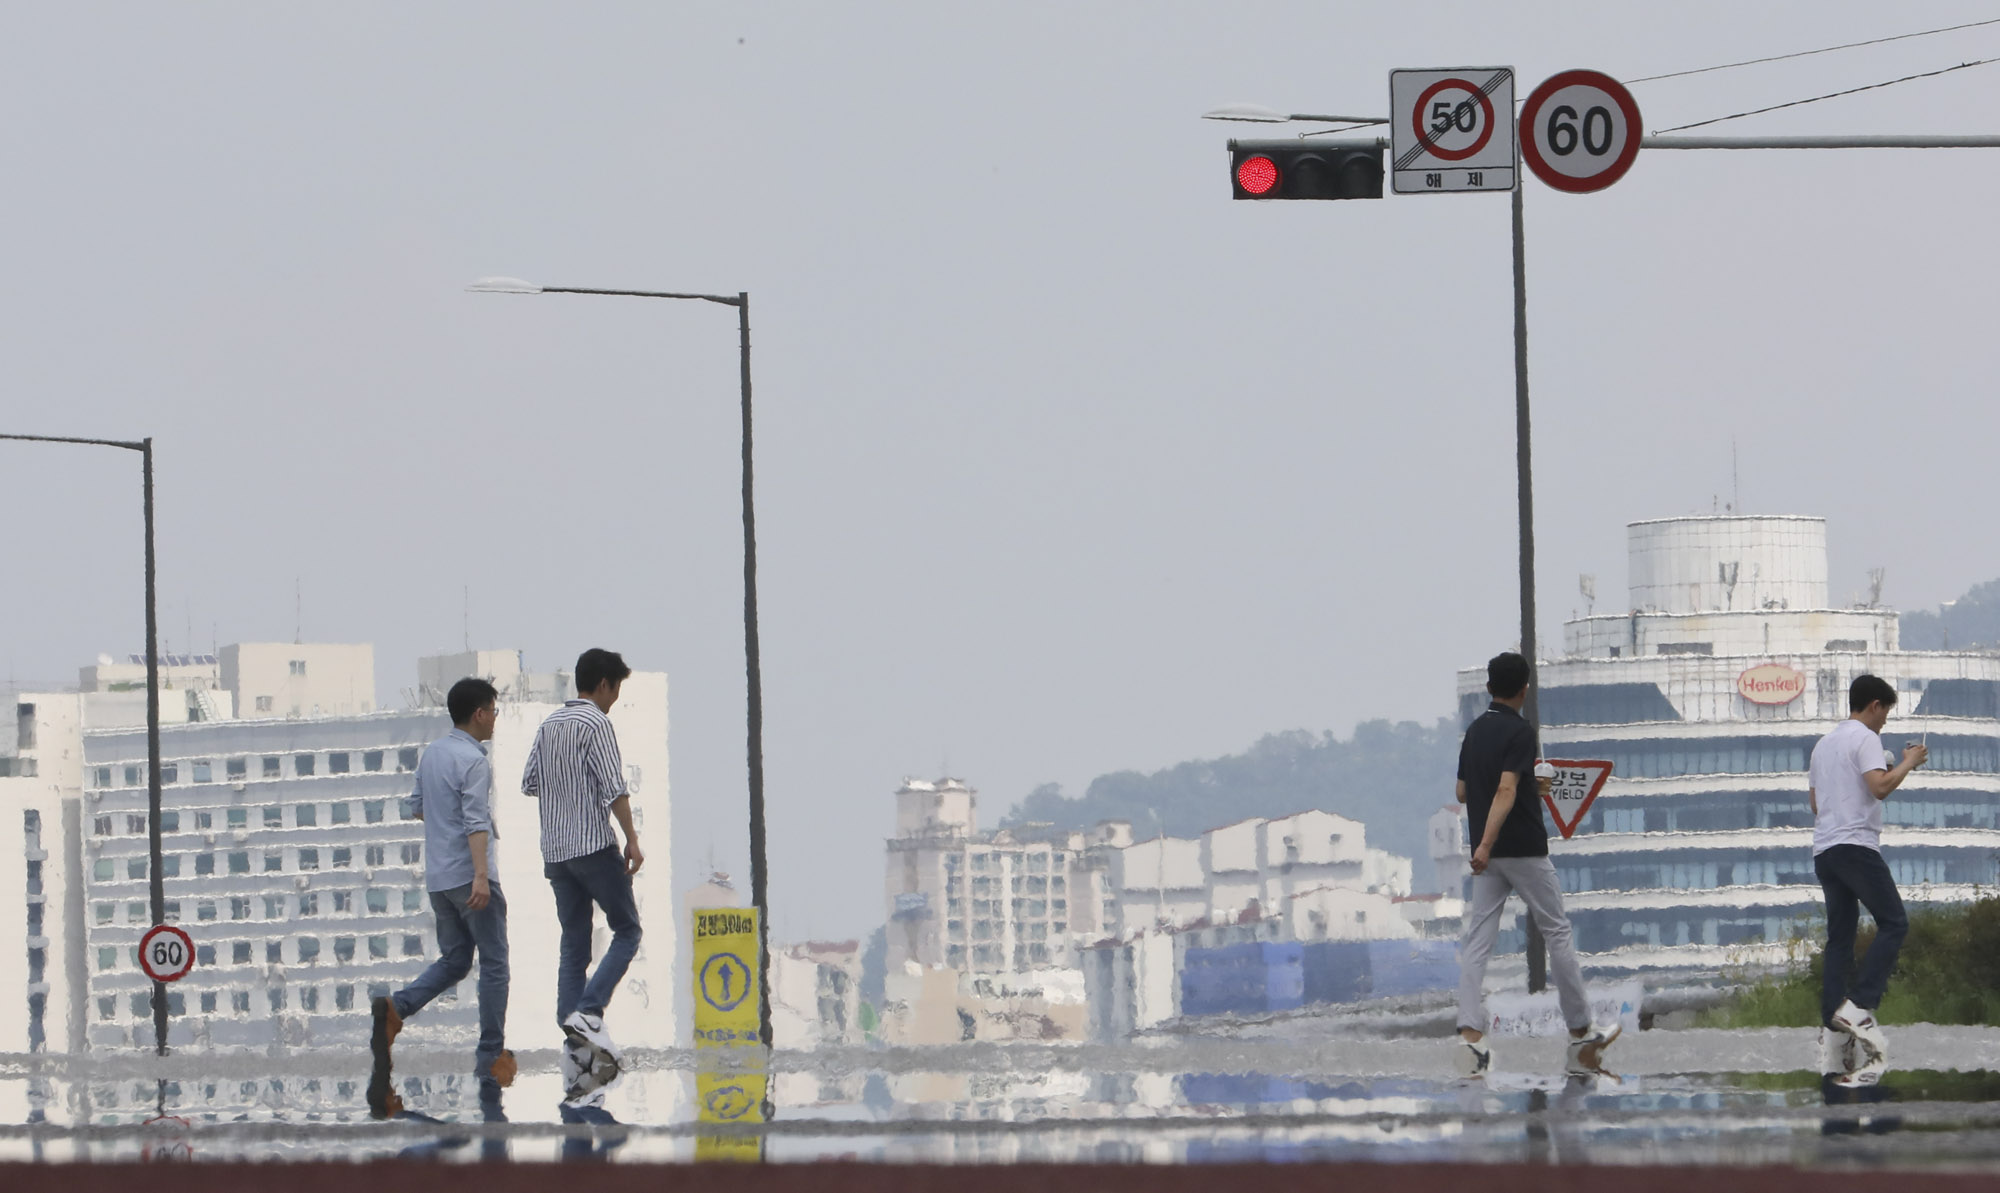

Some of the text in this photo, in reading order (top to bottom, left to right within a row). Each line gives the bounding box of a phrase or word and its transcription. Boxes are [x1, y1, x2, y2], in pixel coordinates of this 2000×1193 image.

[1431, 101, 1476, 133] 50
[1547, 105, 1613, 156] 60
[1743, 676, 1799, 692] Henkel
[1551, 788, 1585, 800] YIELD
[154, 941, 182, 966] 60
